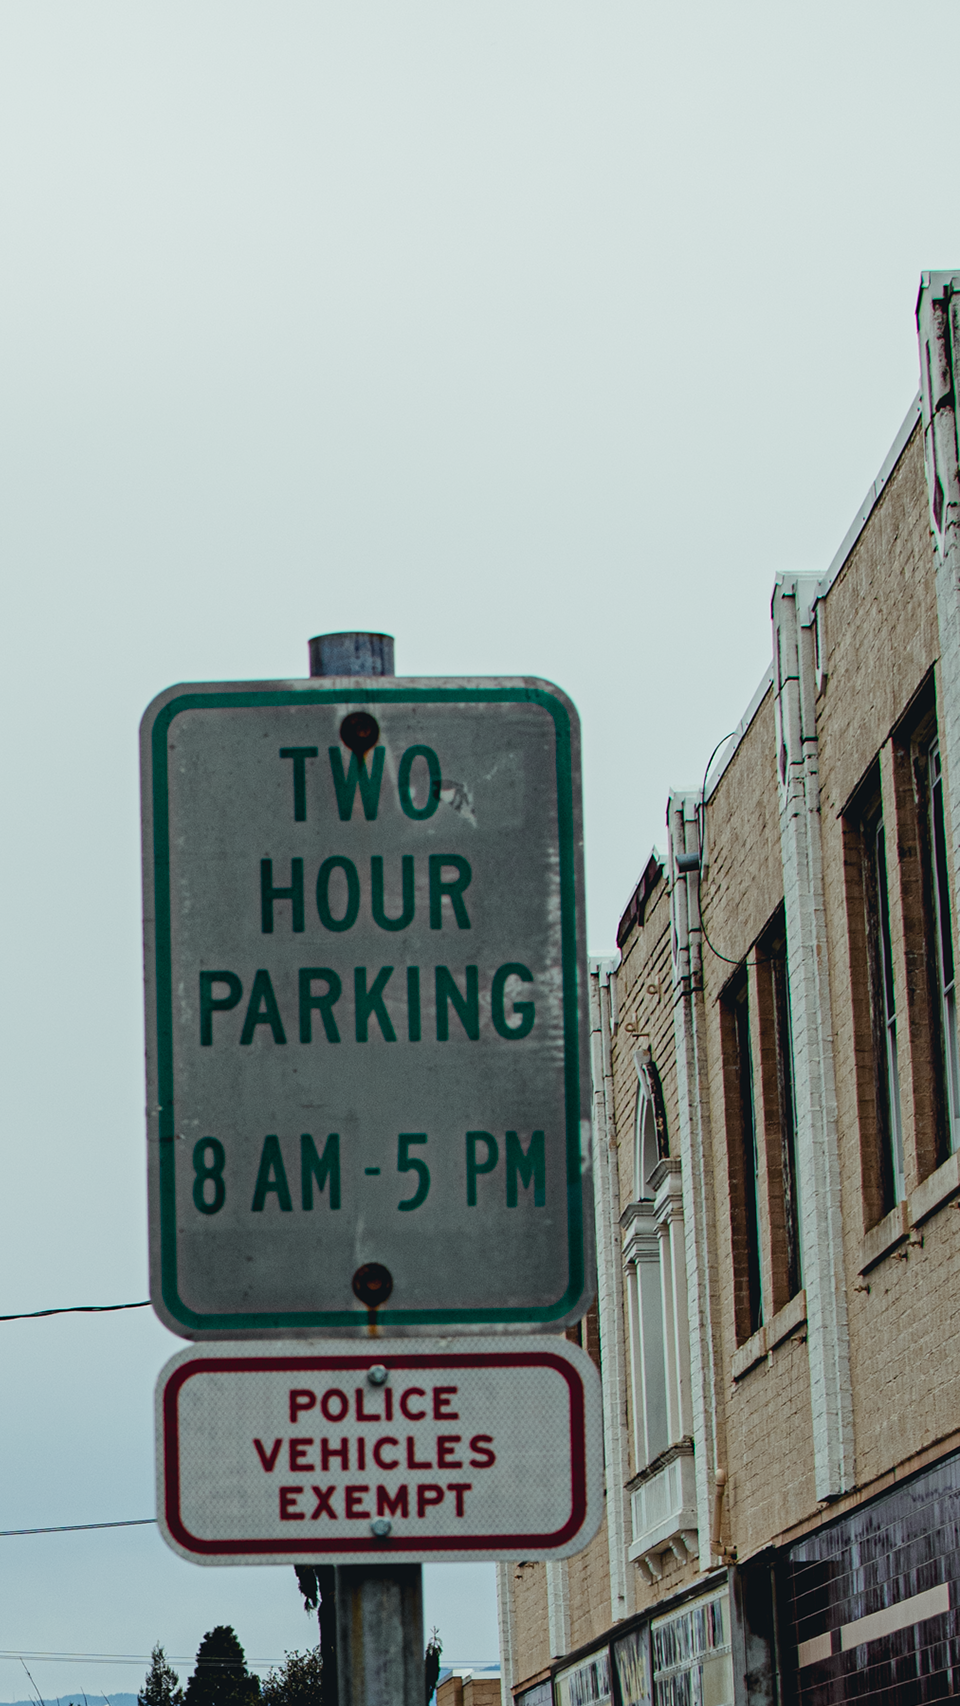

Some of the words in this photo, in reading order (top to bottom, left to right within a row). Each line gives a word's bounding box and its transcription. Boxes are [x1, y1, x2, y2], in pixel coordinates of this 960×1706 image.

[279, 744, 442, 822] TWO
[260, 854, 472, 934] HOUR
[199, 962, 536, 1046] PARKING
[192, 1136, 226, 1215] 8
[251, 1133, 341, 1212] AM
[466, 1130, 546, 1208] PM
[289, 1386, 459, 1423] POLICE
[253, 1435, 496, 1472] VEHICLES
[279, 1483, 472, 1520] EXEMPT
